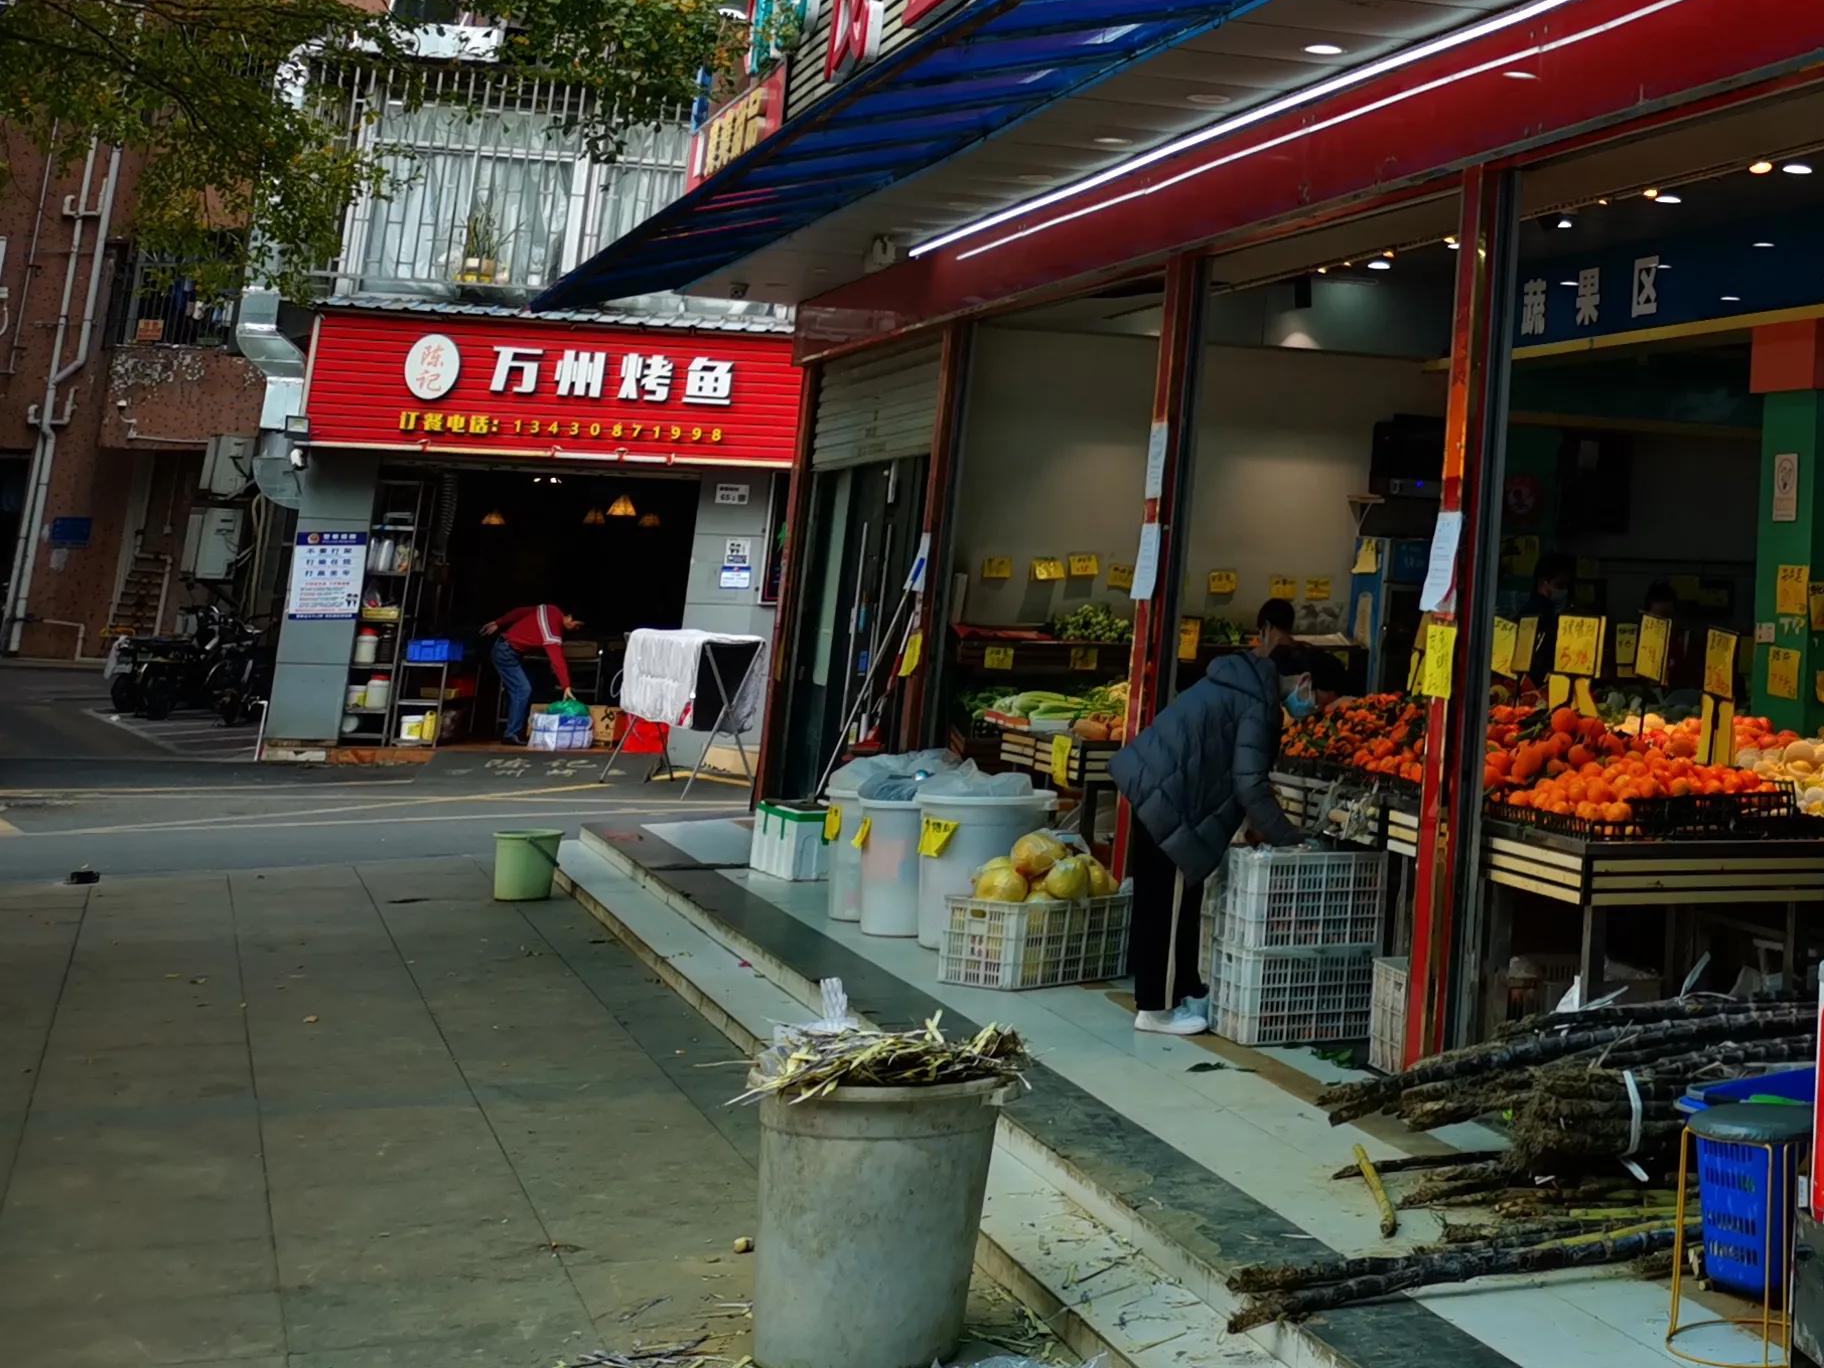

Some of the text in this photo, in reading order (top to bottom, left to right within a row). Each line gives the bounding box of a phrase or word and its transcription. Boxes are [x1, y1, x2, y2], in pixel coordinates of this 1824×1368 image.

[1520, 254, 1661, 336] 蔬果区
[489, 345, 736, 405] 万州烤鱼
